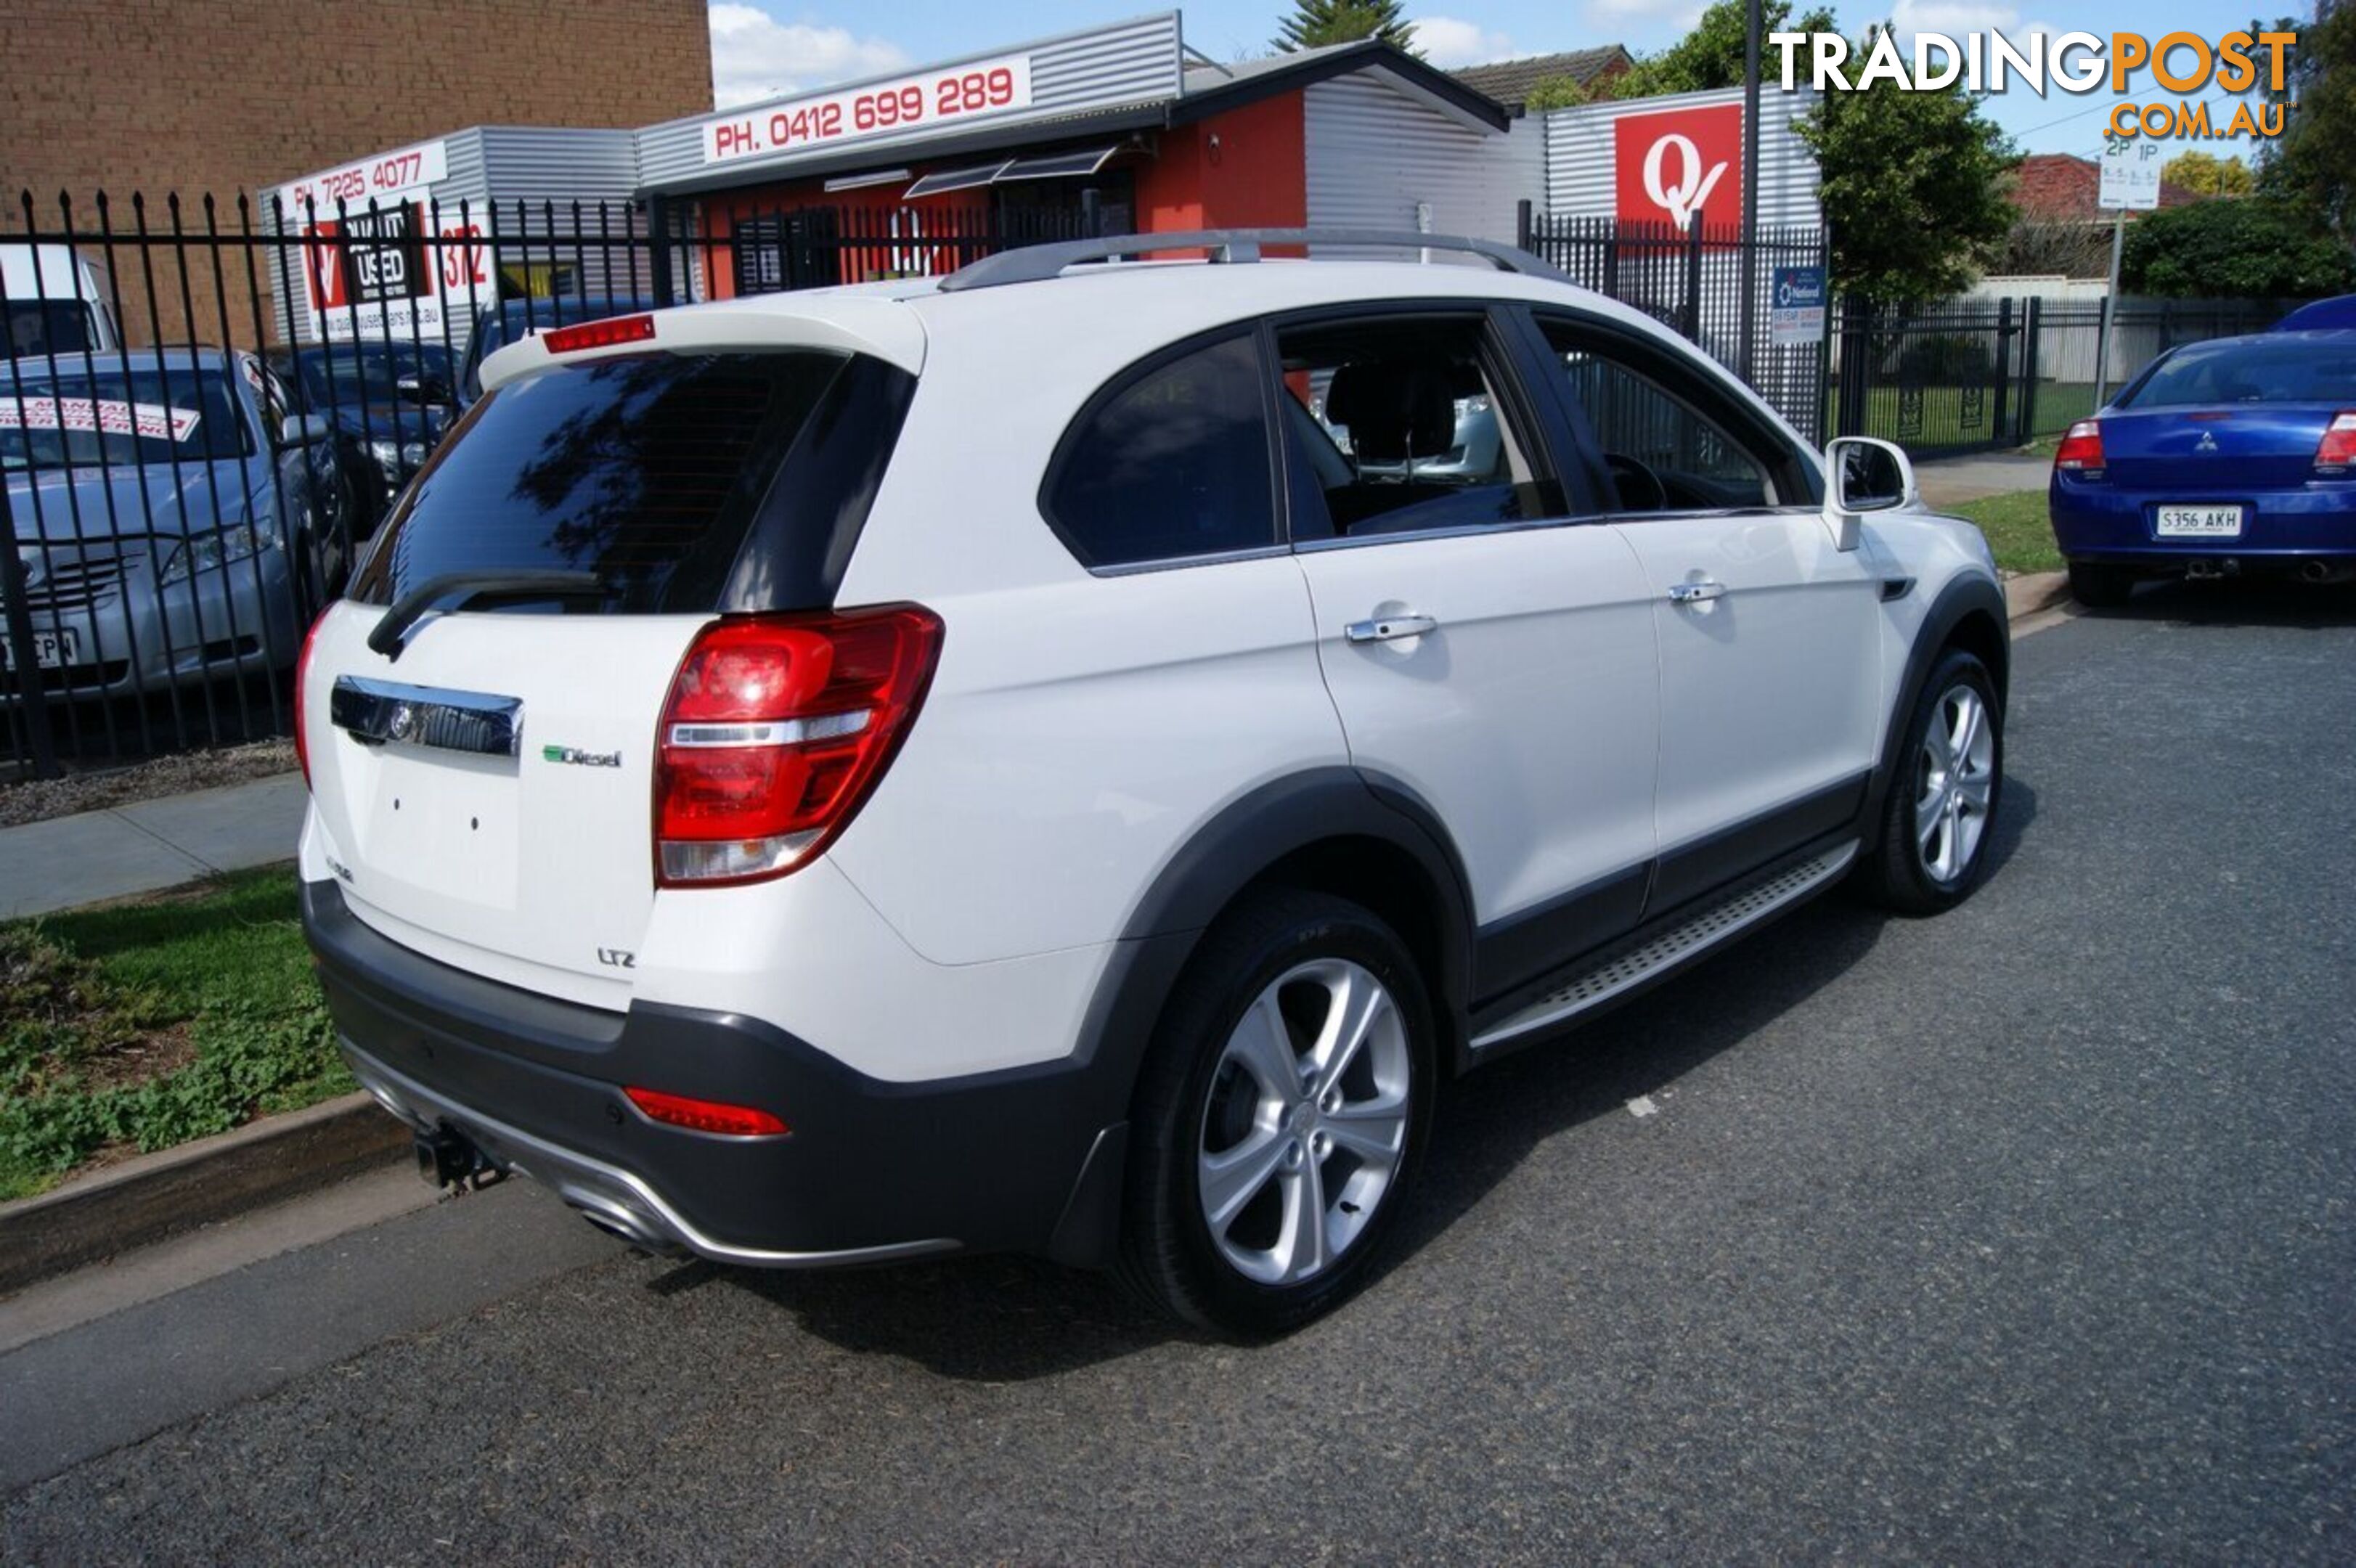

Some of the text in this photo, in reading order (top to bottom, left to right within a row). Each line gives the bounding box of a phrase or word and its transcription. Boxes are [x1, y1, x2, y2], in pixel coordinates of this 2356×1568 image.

[715, 67, 1014, 157] PH. 0412 699 289
[2106, 138, 2130, 155] 2P
[2140, 144, 2158, 161] 1P
[321, 169, 366, 205] 7225
[372, 152, 423, 189] 4077
[356, 249, 404, 287] USED
[442, 224, 486, 287] 372
[2164, 513, 2237, 527] S356 AKH
